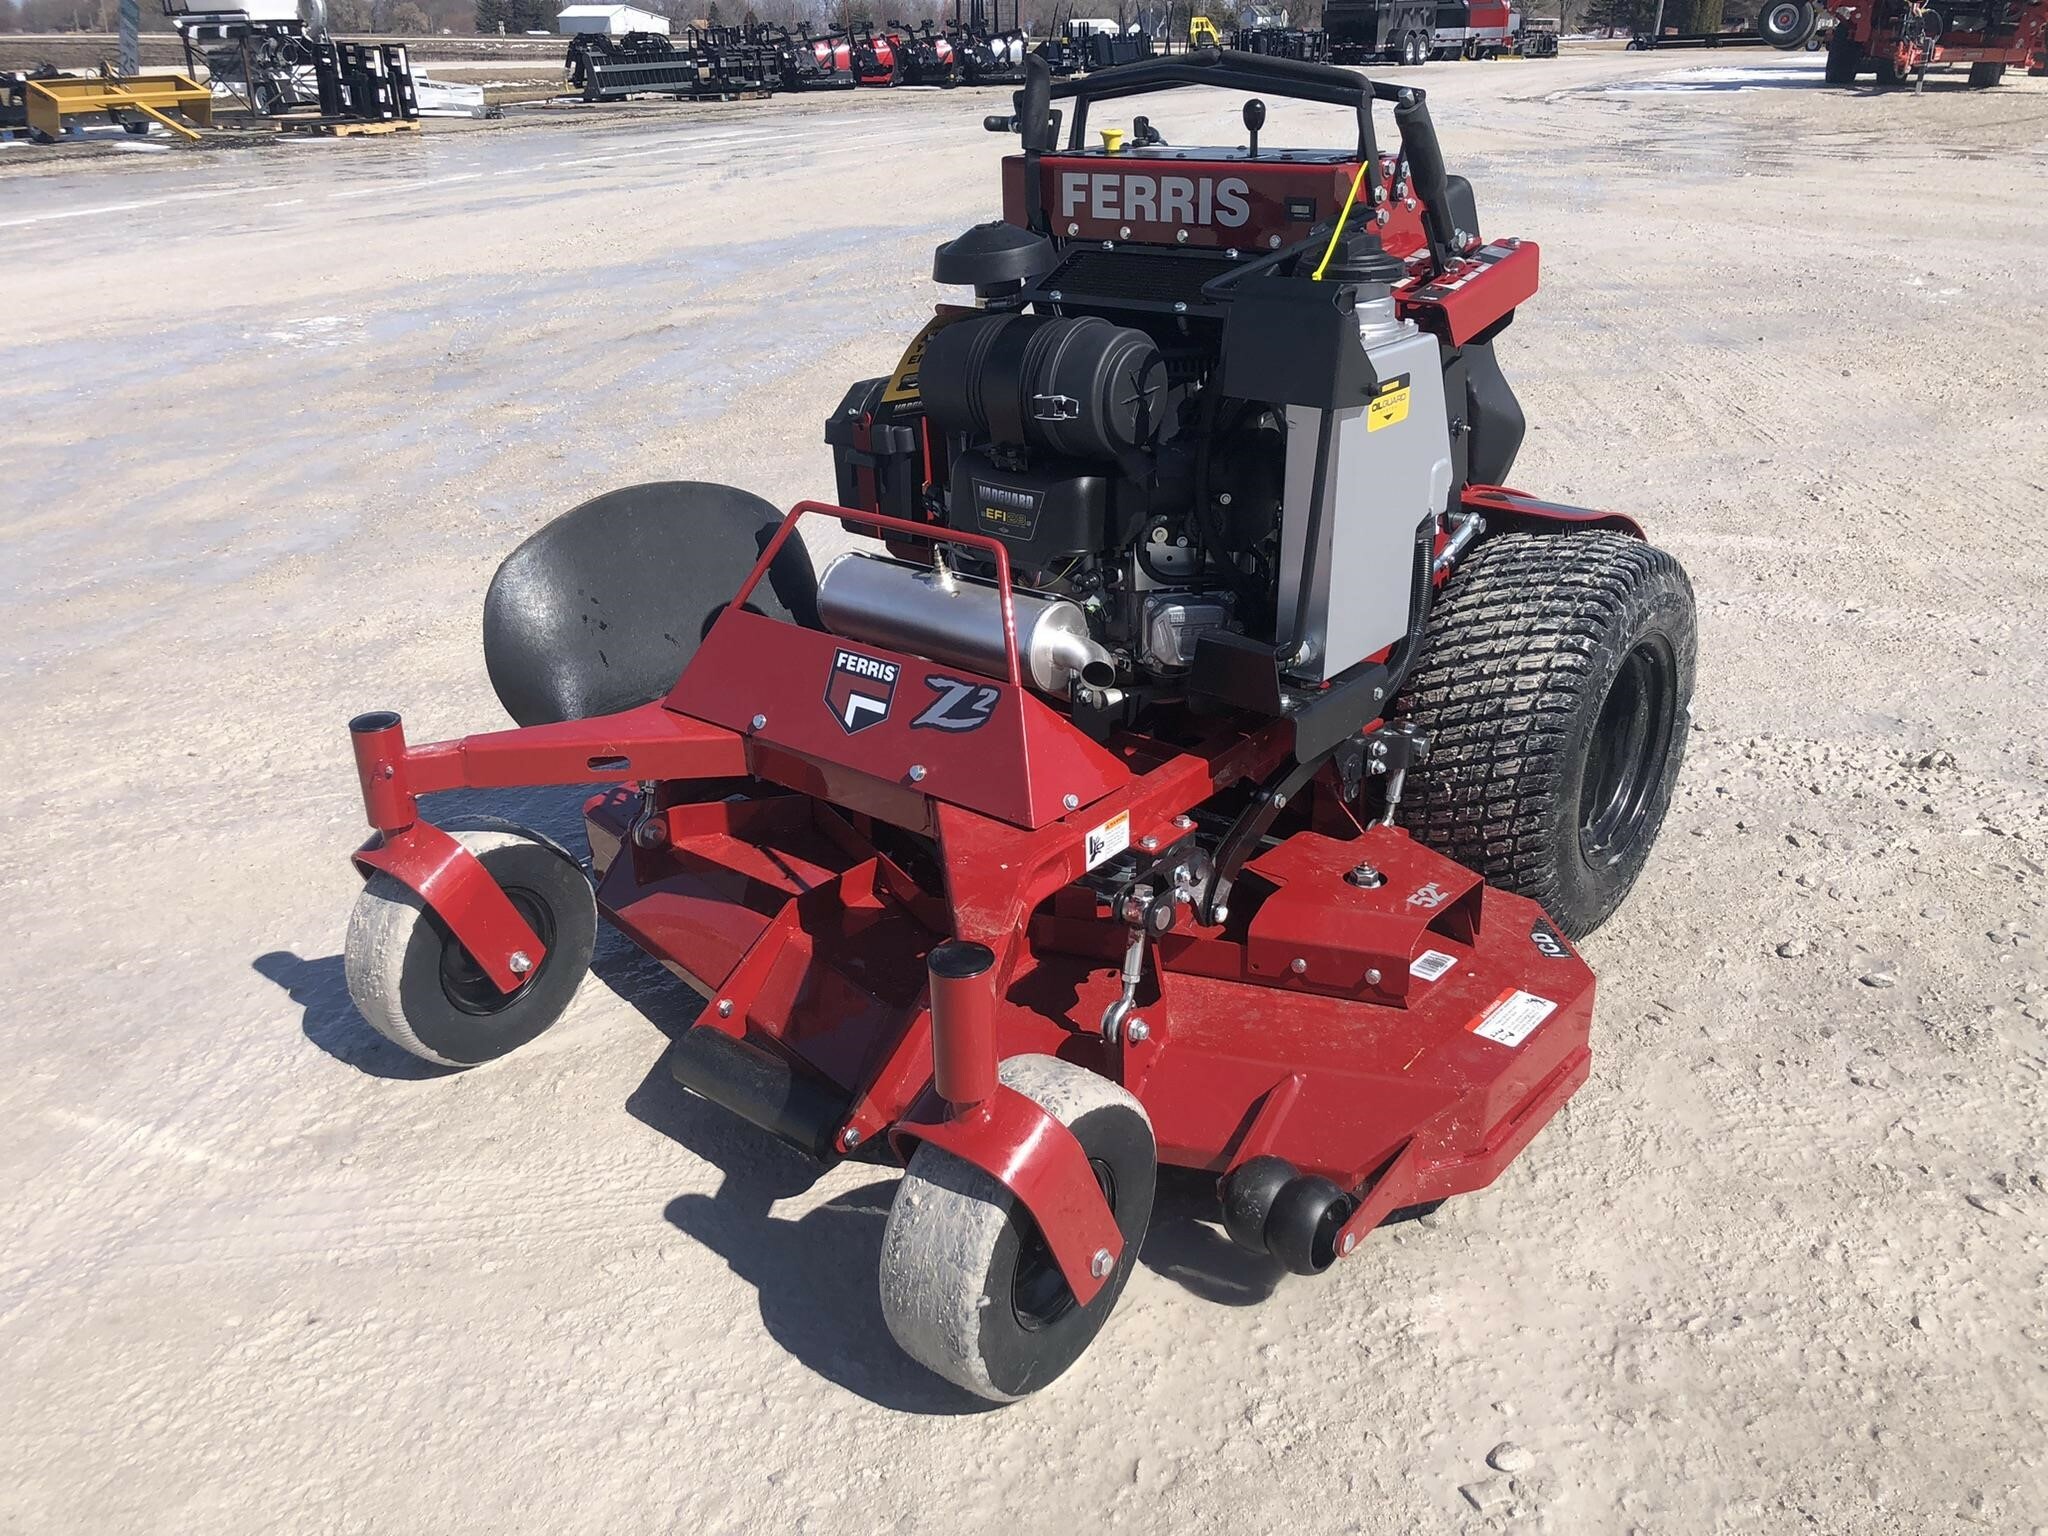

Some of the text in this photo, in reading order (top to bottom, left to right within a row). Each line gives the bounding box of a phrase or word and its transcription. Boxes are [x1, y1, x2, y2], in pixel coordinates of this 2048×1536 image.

[1062, 172, 1250, 228] FERRIS
[979, 485, 1034, 510] VANGUARD
[836, 652, 895, 682] FERRIS
